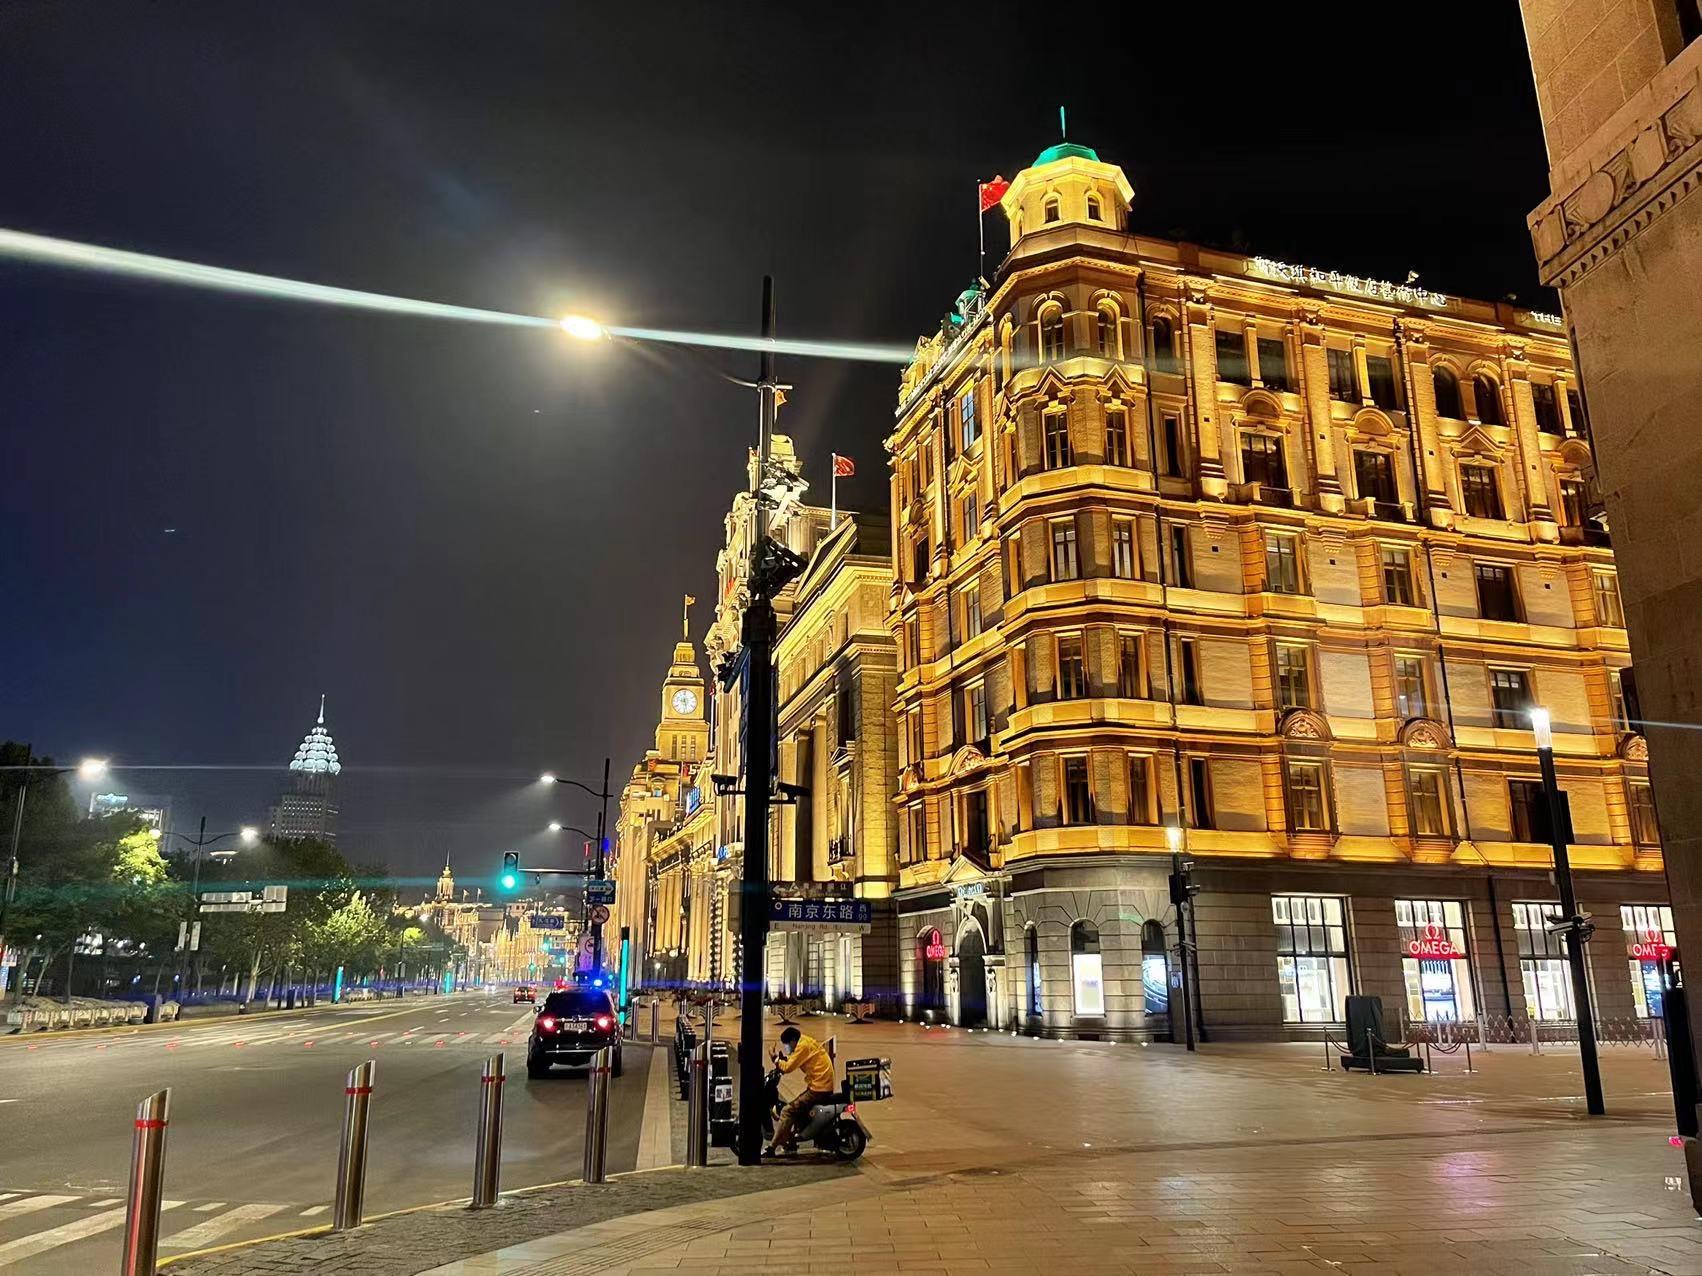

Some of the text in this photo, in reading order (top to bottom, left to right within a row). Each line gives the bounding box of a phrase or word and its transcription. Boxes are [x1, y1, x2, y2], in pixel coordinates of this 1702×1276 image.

[788, 903, 853, 919] 南京东路
[792, 923, 815, 931] Nanjing
[1409, 940, 1460, 955] OMEGA
[1632, 943, 1668, 957] OME
